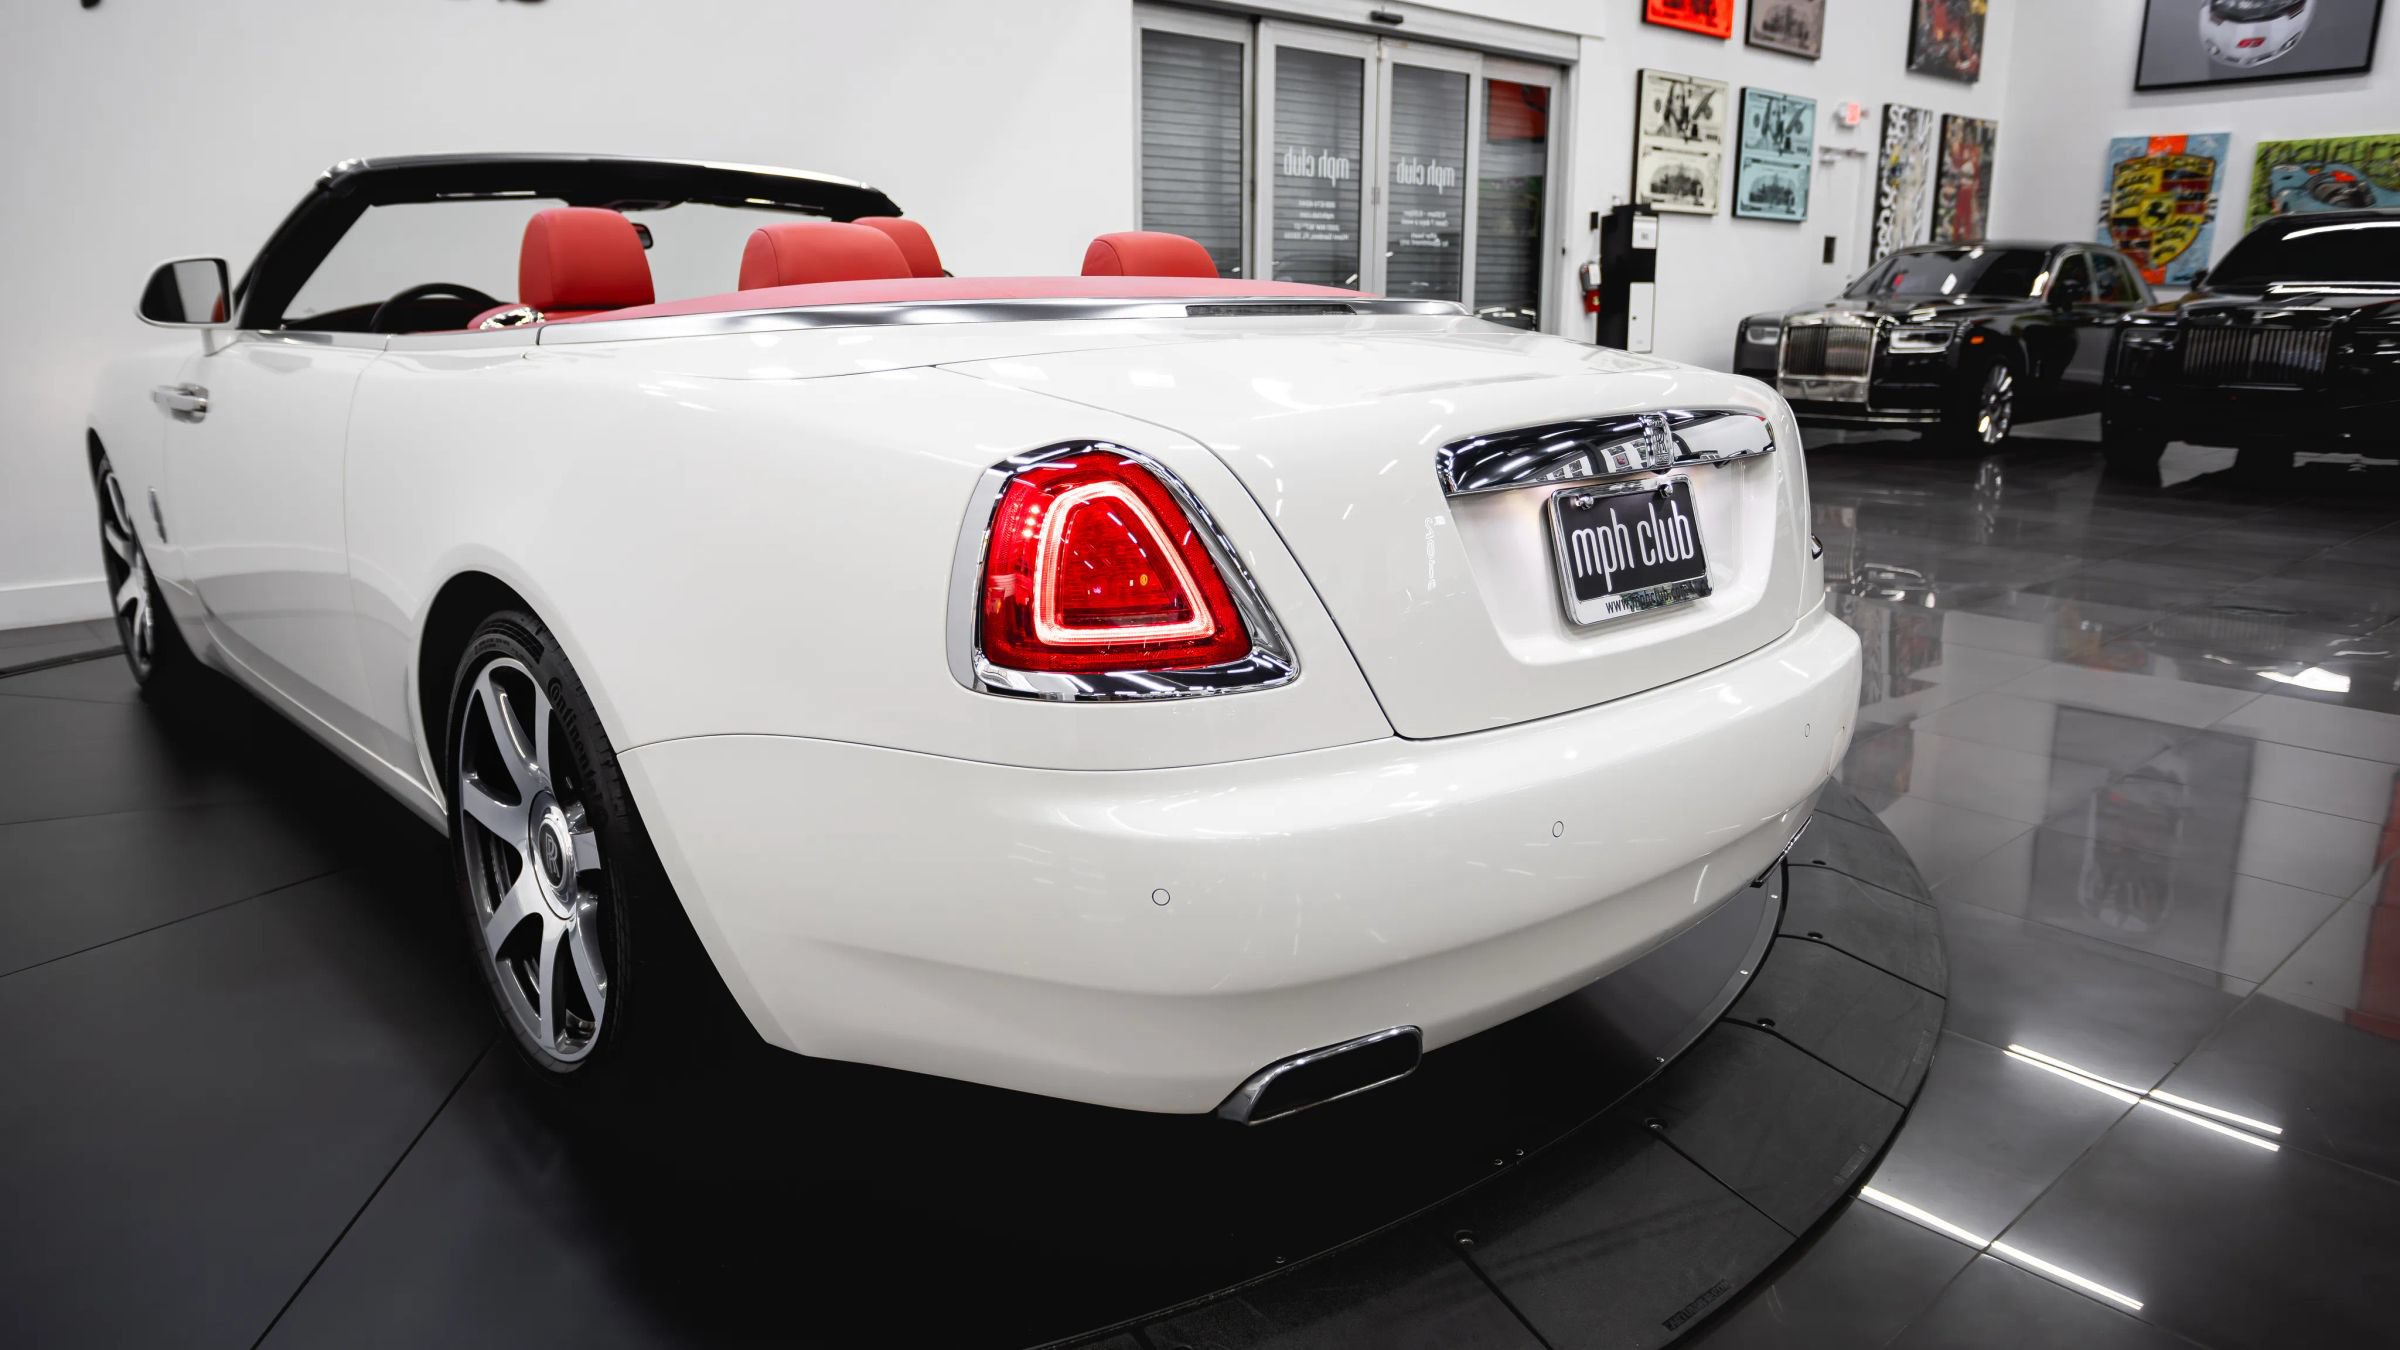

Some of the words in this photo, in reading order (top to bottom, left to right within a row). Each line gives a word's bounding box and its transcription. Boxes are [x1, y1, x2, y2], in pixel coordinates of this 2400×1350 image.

[1571, 507, 1635, 592] mph
[1637, 500, 1694, 566] club
[548, 677, 604, 799] Continental
